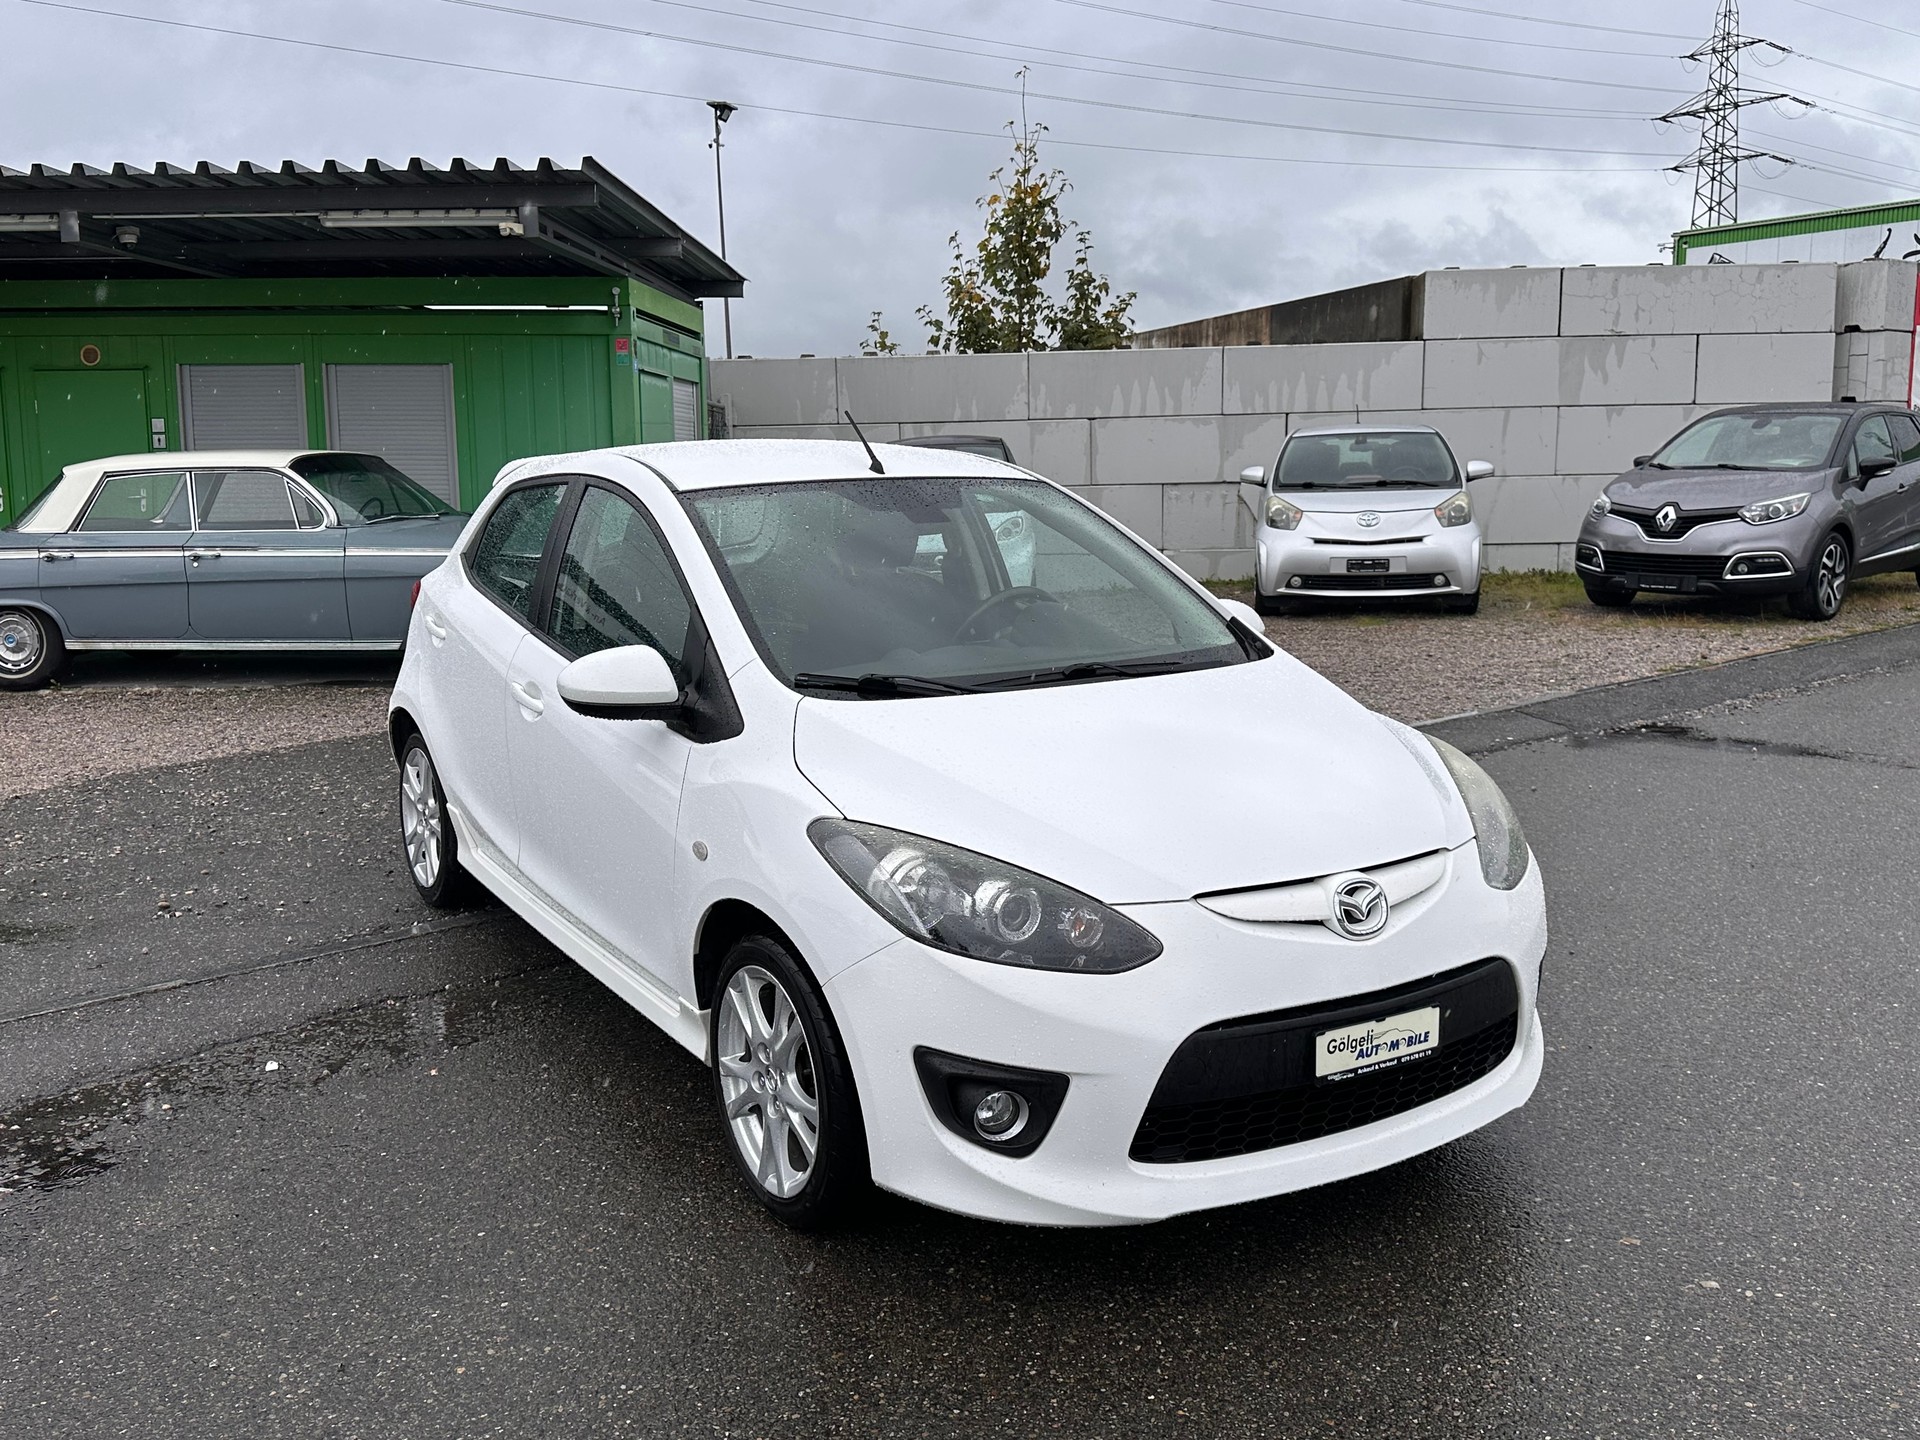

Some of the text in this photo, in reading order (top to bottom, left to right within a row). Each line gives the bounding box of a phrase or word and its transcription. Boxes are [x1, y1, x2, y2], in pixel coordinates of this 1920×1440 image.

[1327, 1029, 1374, 1055] Gölgeli
[1357, 1064, 1375, 1075] Ankauf
[1379, 1058, 1398, 1068] Verkauf
